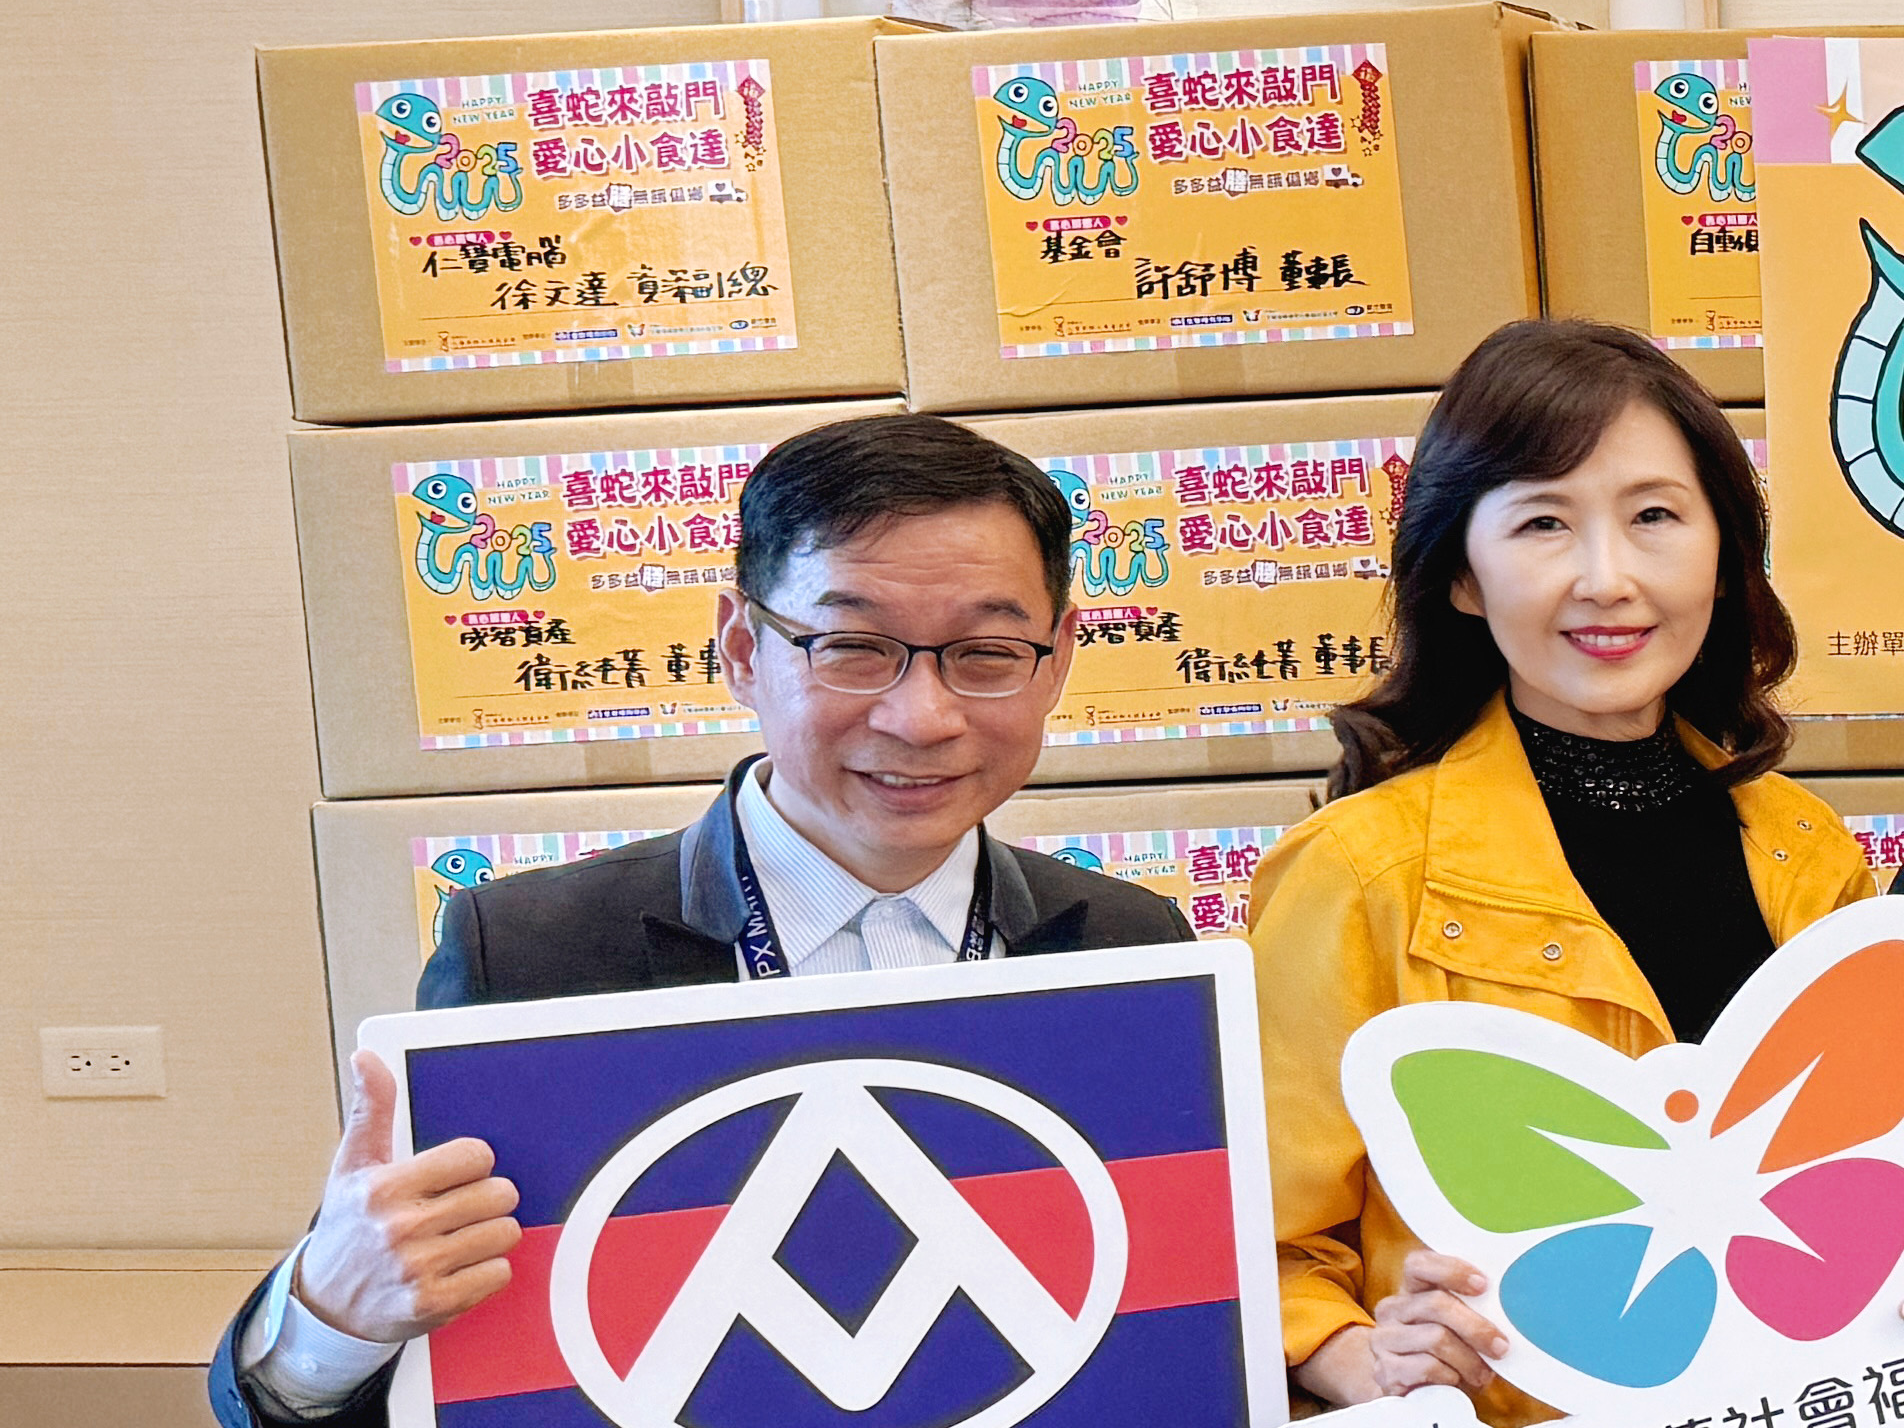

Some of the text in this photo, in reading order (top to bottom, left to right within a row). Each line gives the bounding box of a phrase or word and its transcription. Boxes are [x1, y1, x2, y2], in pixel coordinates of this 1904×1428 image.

[526, 80, 722, 126] 喜蛇來敲門
[1143, 64, 1339, 110] 喜蛇來敲門
[434, 129, 521, 173] 2025
[531, 127, 727, 176] 愛心小食達
[1050, 113, 1137, 158] 2025
[1147, 111, 1344, 161] 愛心小食達
[1039, 228, 1127, 264] 基金會
[1174, 457, 1367, 502] 喜蛇來敲門
[469, 510, 555, 553] 2025
[1082, 506, 1168, 549] 2025
[1178, 503, 1372, 552] 愛心小食達
